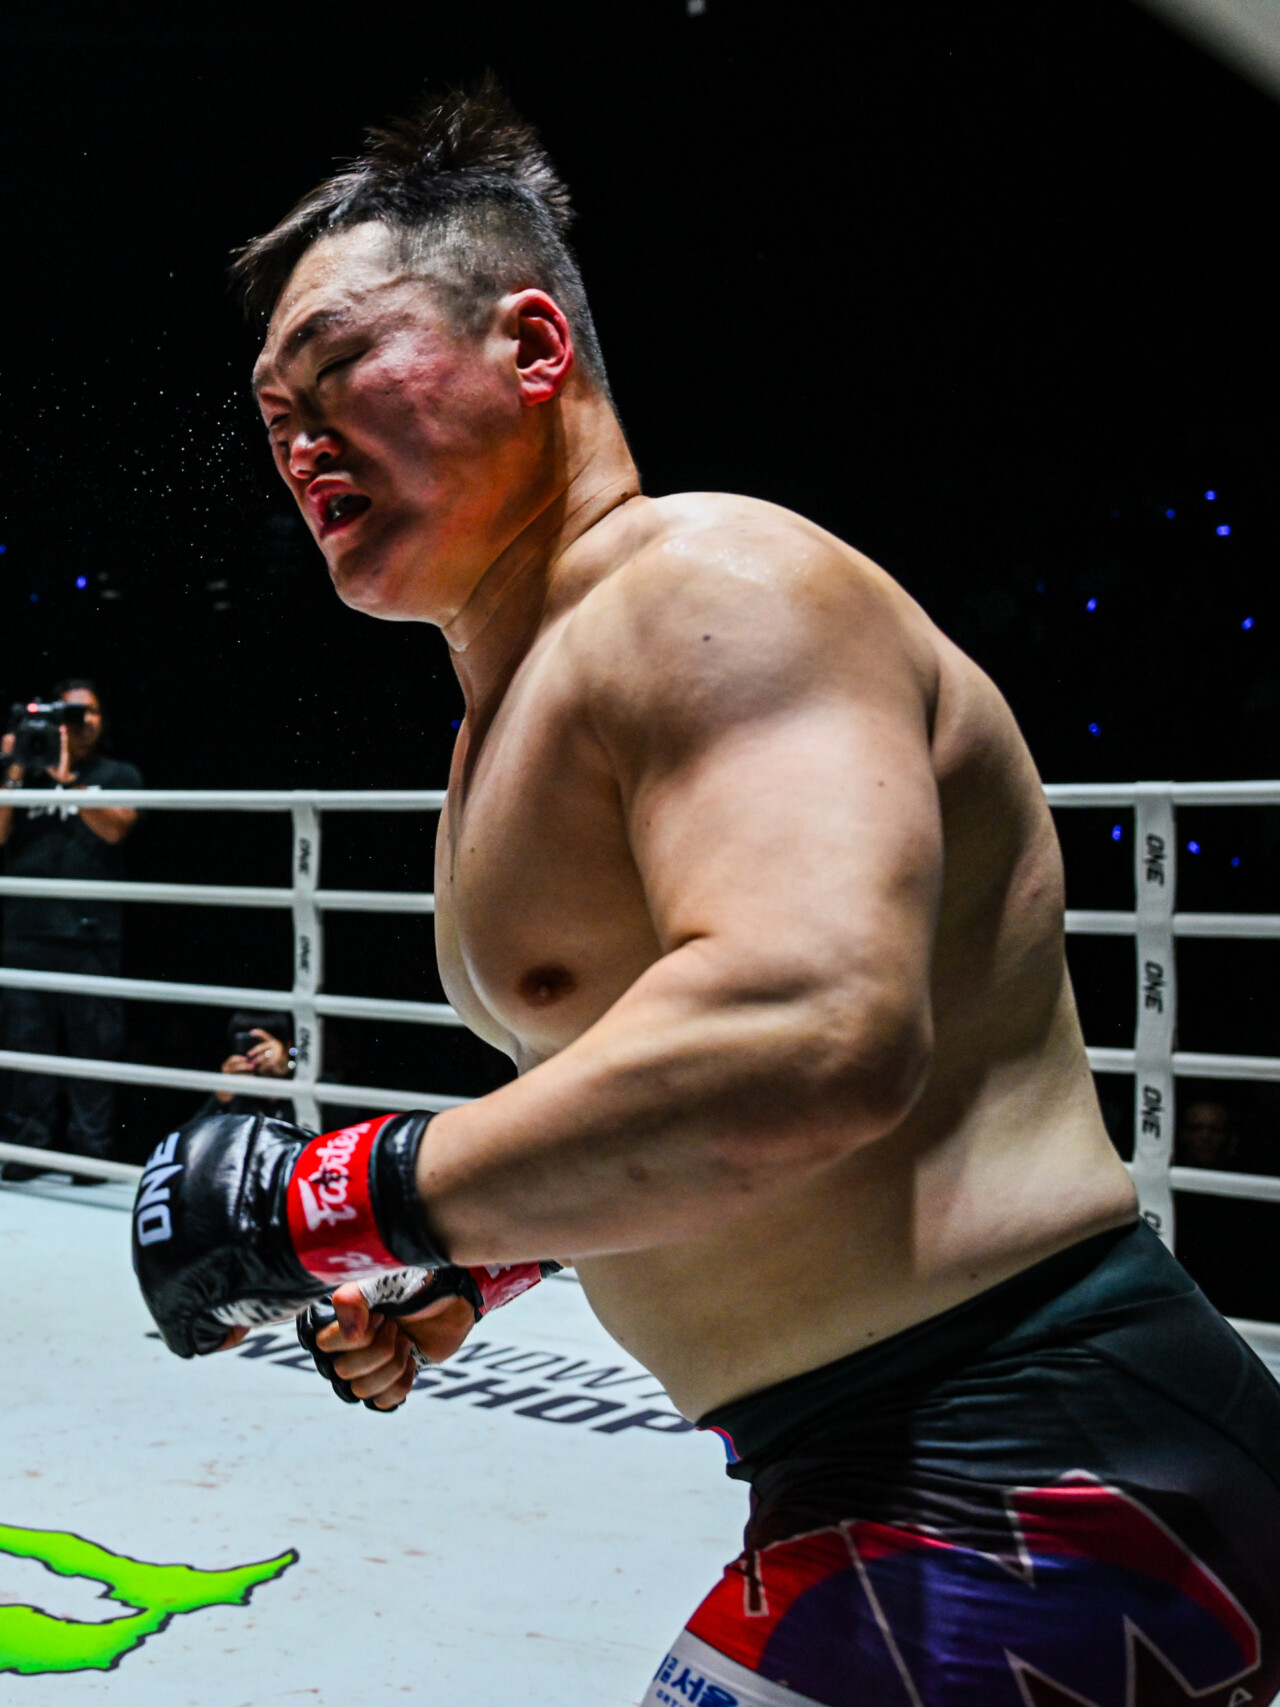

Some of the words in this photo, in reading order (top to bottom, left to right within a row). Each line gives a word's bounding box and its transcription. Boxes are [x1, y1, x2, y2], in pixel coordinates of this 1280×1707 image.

[1145, 834, 1165, 887] ONE
[1143, 961, 1163, 1014] ONE
[1142, 1086, 1162, 1140] ONE
[136, 1131, 184, 1247] ONE
